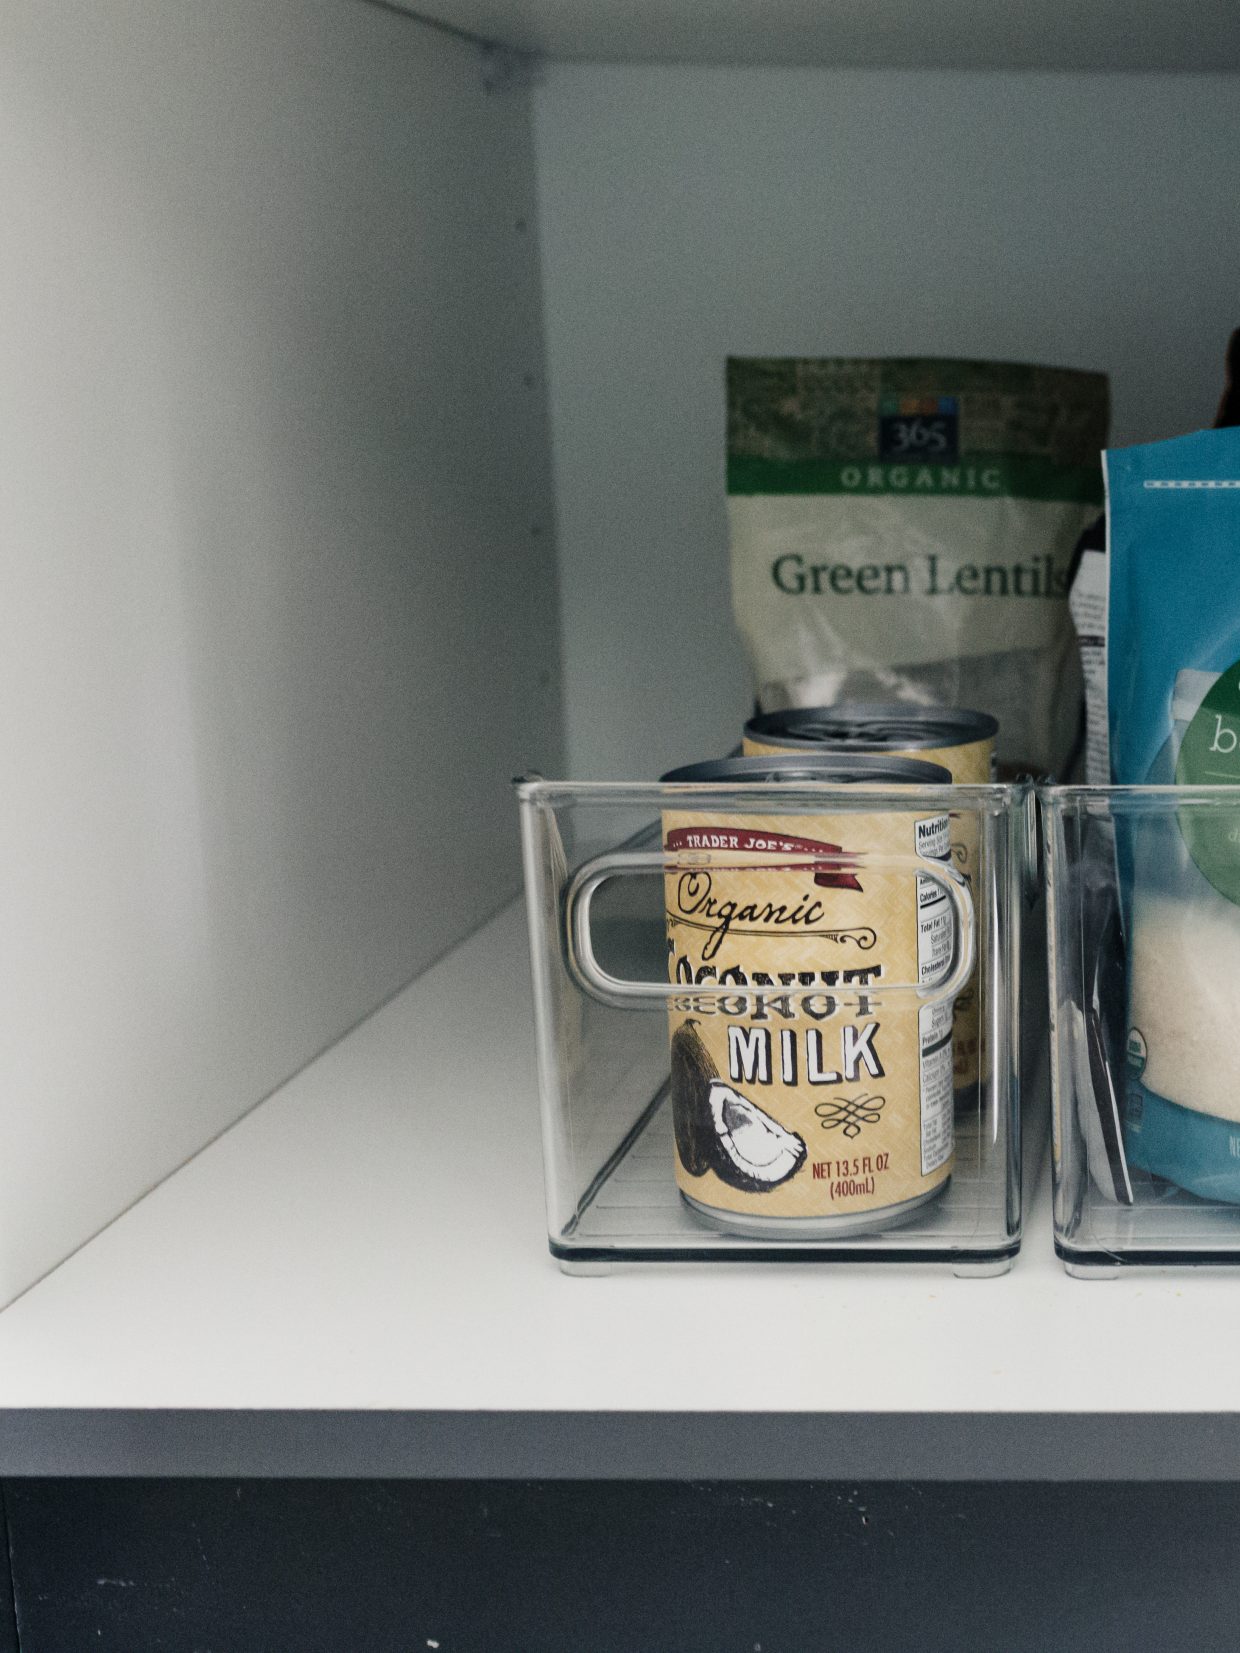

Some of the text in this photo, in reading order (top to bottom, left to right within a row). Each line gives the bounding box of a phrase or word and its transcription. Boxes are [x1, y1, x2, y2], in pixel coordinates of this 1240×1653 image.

[892, 419, 947, 452] 365
[840, 465, 1002, 490] ORGANIC
[771, 553, 911, 597] Green
[686, 834, 794, 851] TRADER JOE'S
[677, 870, 825, 961] Organic
[727, 1022, 886, 1087] MILK
[812, 1151, 890, 1180] NET 13.5 FL OZ
[829, 1176, 875, 1200] (400mL)
